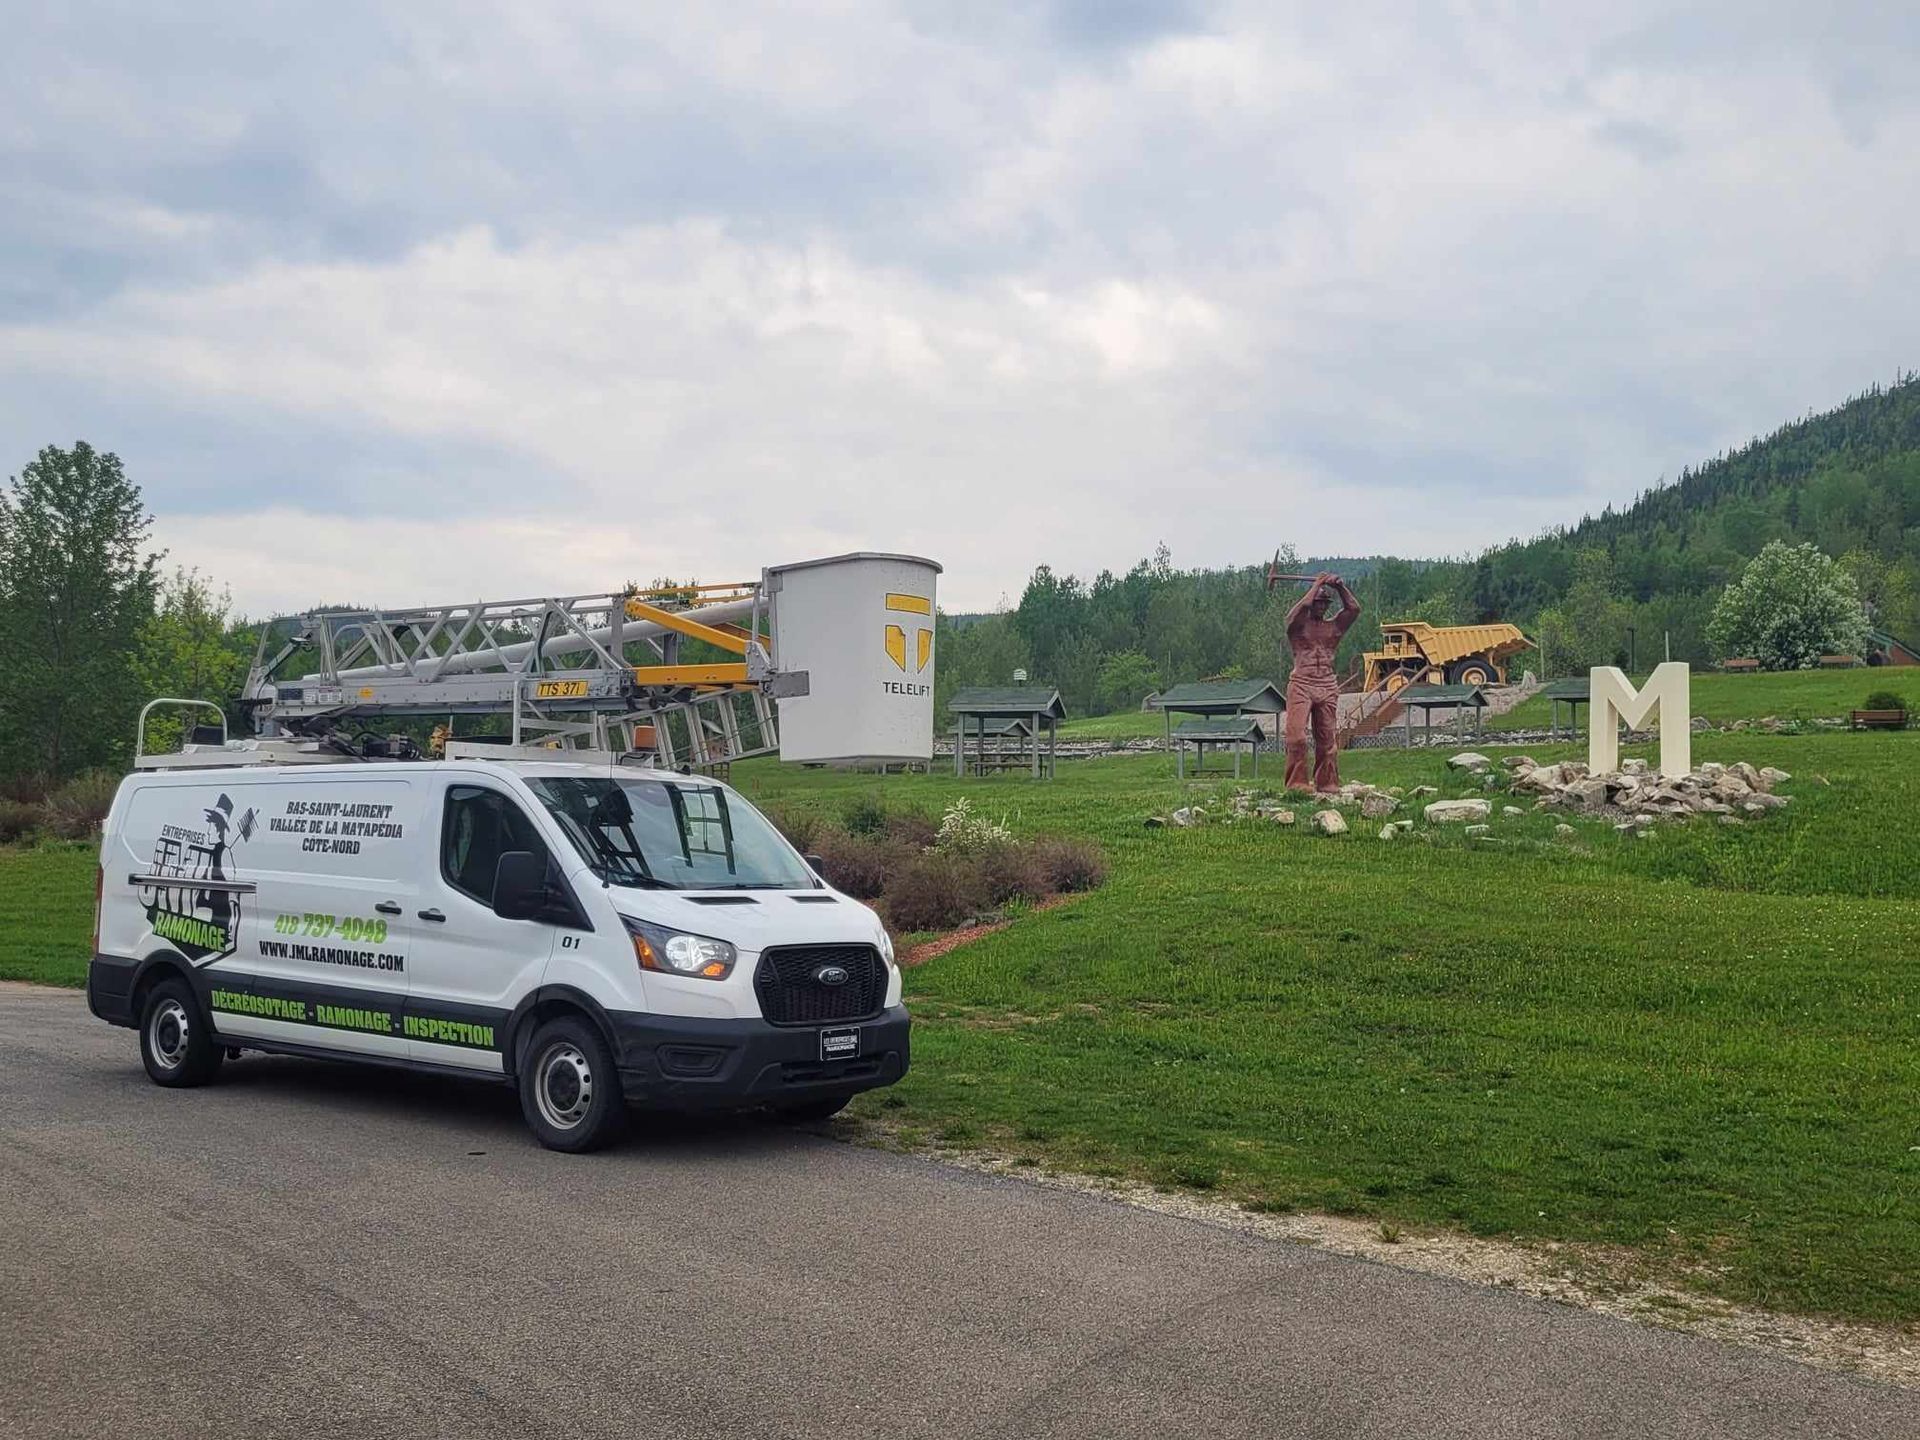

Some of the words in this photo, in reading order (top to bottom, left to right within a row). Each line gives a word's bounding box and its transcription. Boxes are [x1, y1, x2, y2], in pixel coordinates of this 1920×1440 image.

[540, 683, 560, 695] TTS
[883, 682, 931, 697] TELELIFT
[1589, 662, 1690, 777] M
[286, 801, 393, 819] BAS-SAINT-LAURENT
[161, 824, 206, 845] ENTREPRISES
[270, 816, 306, 833] VALLÉE
[308, 820, 322, 833] DE
[325, 821, 338, 835] LA
[154, 911, 226, 952] RAMONAGE
[274, 914, 299, 935] 418
[302, 913, 388, 944] 737-4048
[562, 936, 581, 950] 01
[259, 941, 404, 972] WWW.JMLRAMONAGE.COM
[316, 1004, 392, 1032] RAMONAGE
[403, 1016, 494, 1046] INSPECTION
